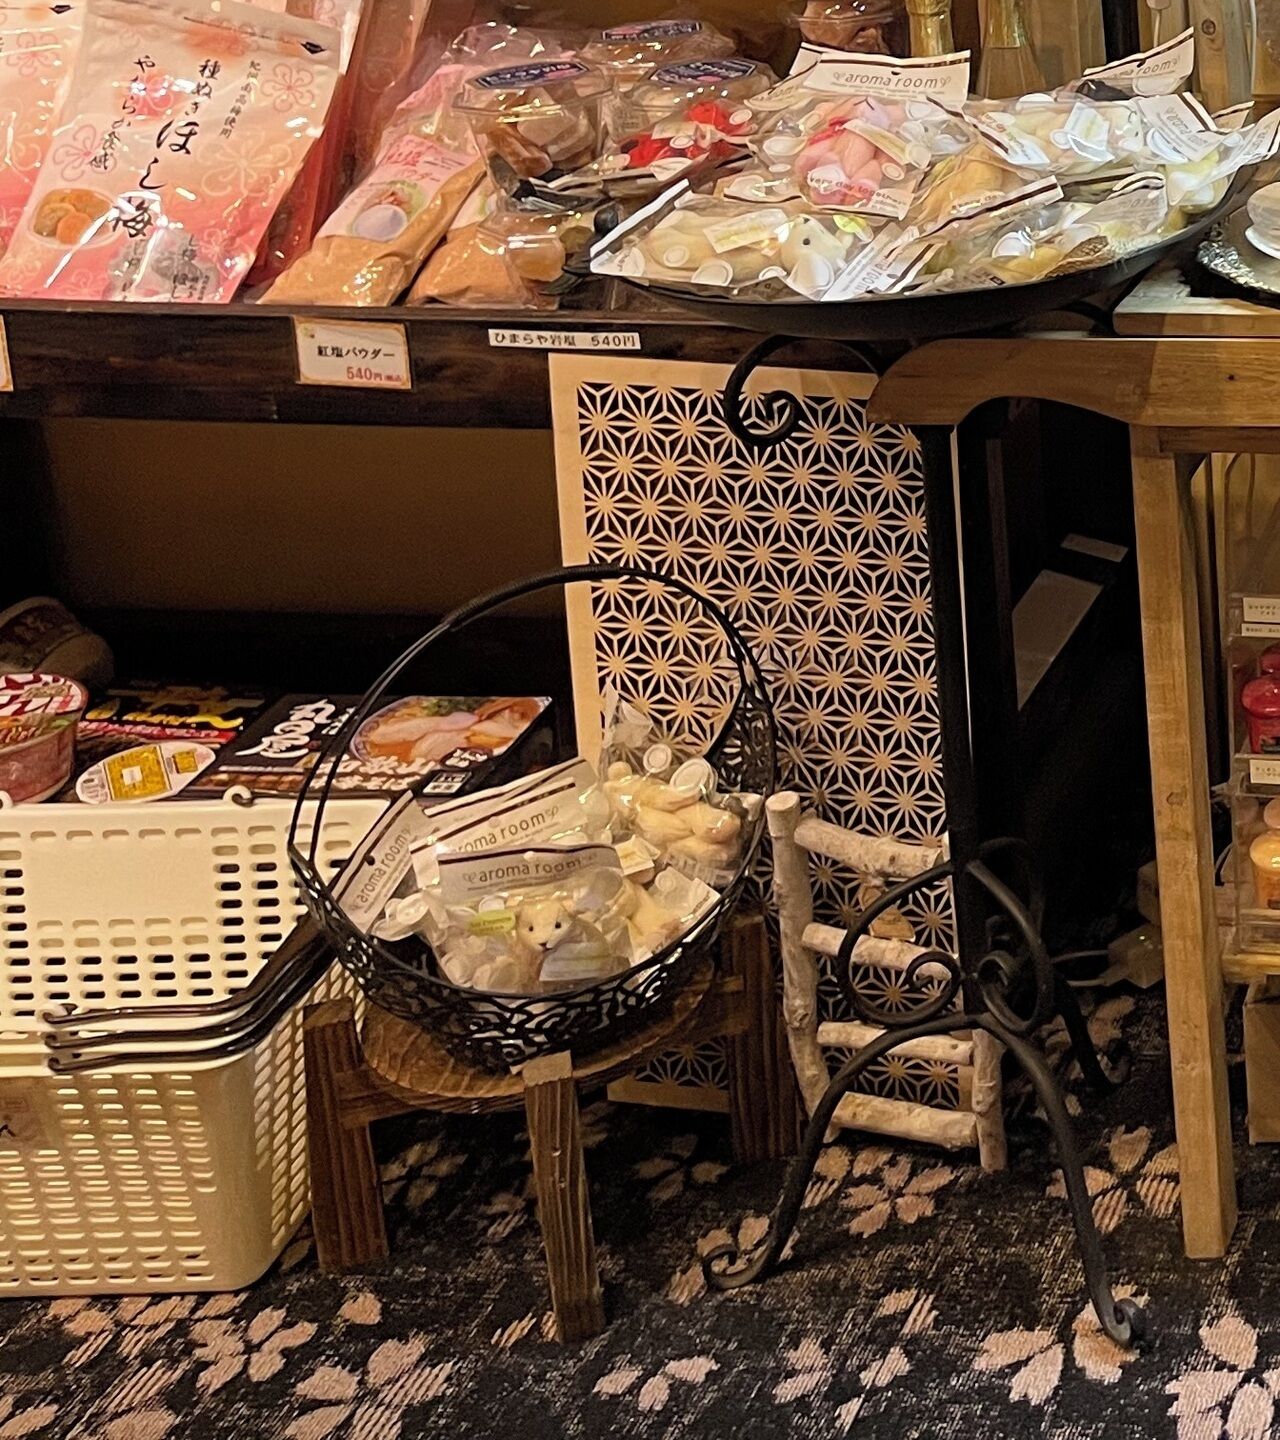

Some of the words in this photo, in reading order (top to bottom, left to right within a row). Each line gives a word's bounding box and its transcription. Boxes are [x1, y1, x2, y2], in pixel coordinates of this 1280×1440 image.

[185, 59, 221, 116] 種ぬき
[845, 71, 892, 87] aroma
[895, 74, 940, 90] room
[317, 345, 396, 360] 紅塩パウダー
[494, 332, 576, 347] ひまらや岩塩
[590, 335, 636, 347] 540円
[453, 831, 498, 853] roma
[500, 811, 547, 838] room
[357, 870, 384, 905] aroma
[379, 836, 407, 870] room
[479, 864, 531, 883] aroma
[535, 857, 582, 875] room
